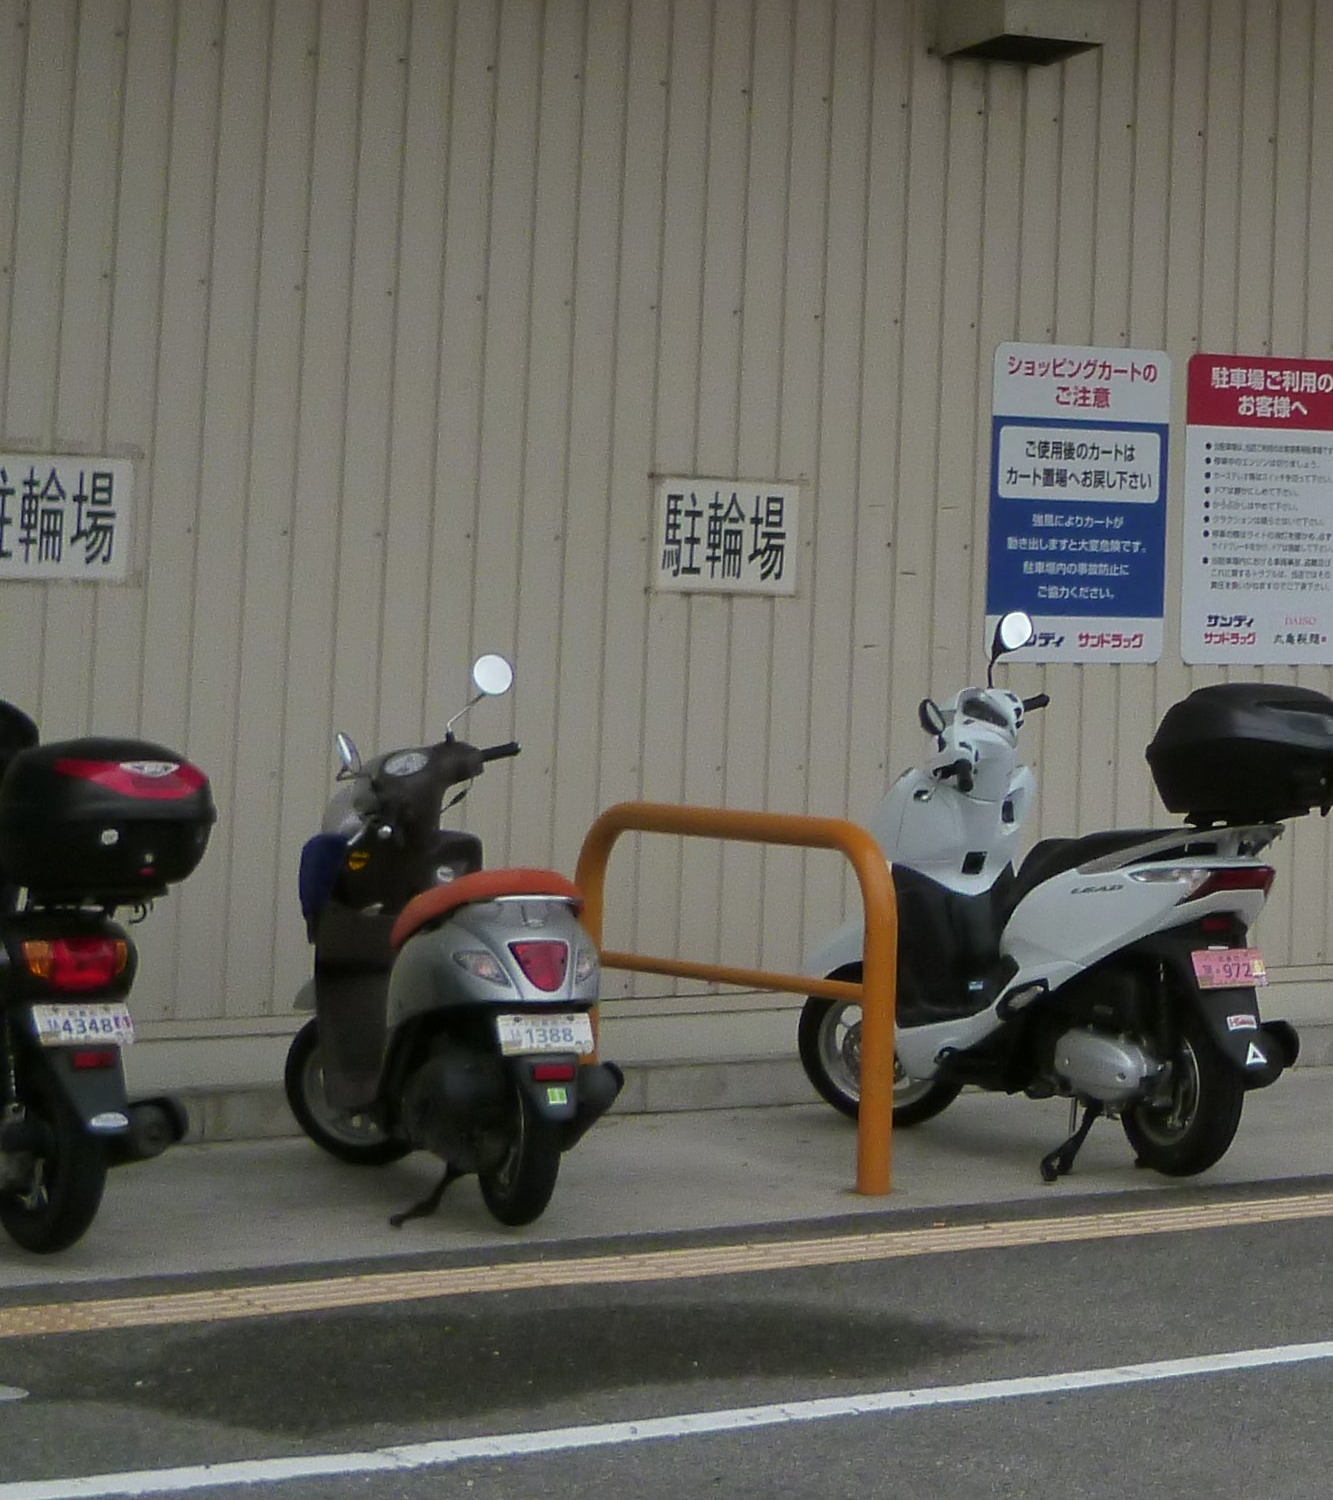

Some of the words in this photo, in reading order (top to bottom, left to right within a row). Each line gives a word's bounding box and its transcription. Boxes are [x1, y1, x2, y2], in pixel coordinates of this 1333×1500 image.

[1007, 355, 1158, 383] ショッピングカートの
[1055, 385, 1111, 409] ご注意
[1237, 395, 1309, 418] お客様へ
[1025, 440, 1136, 462] ご使用後のカートは
[1005, 466, 1152, 491] カート置場へお戻し下さい
[1032, 513, 1124, 529] 強風によりカートが
[661, 491, 786, 581] 駐輪場
[1036, 585, 1115, 600] ご協力ください。
[1206, 614, 1255, 628] サンディ
[1077, 631, 1145, 649] サンドラッグ
[1203, 631, 1257, 645] サンドラッグ
[1069, 883, 1124, 895] LEAD
[1222, 962, 1253, 978] 972
[62, 1017, 113, 1035] 4348
[525, 1028, 574, 1044] 1388
